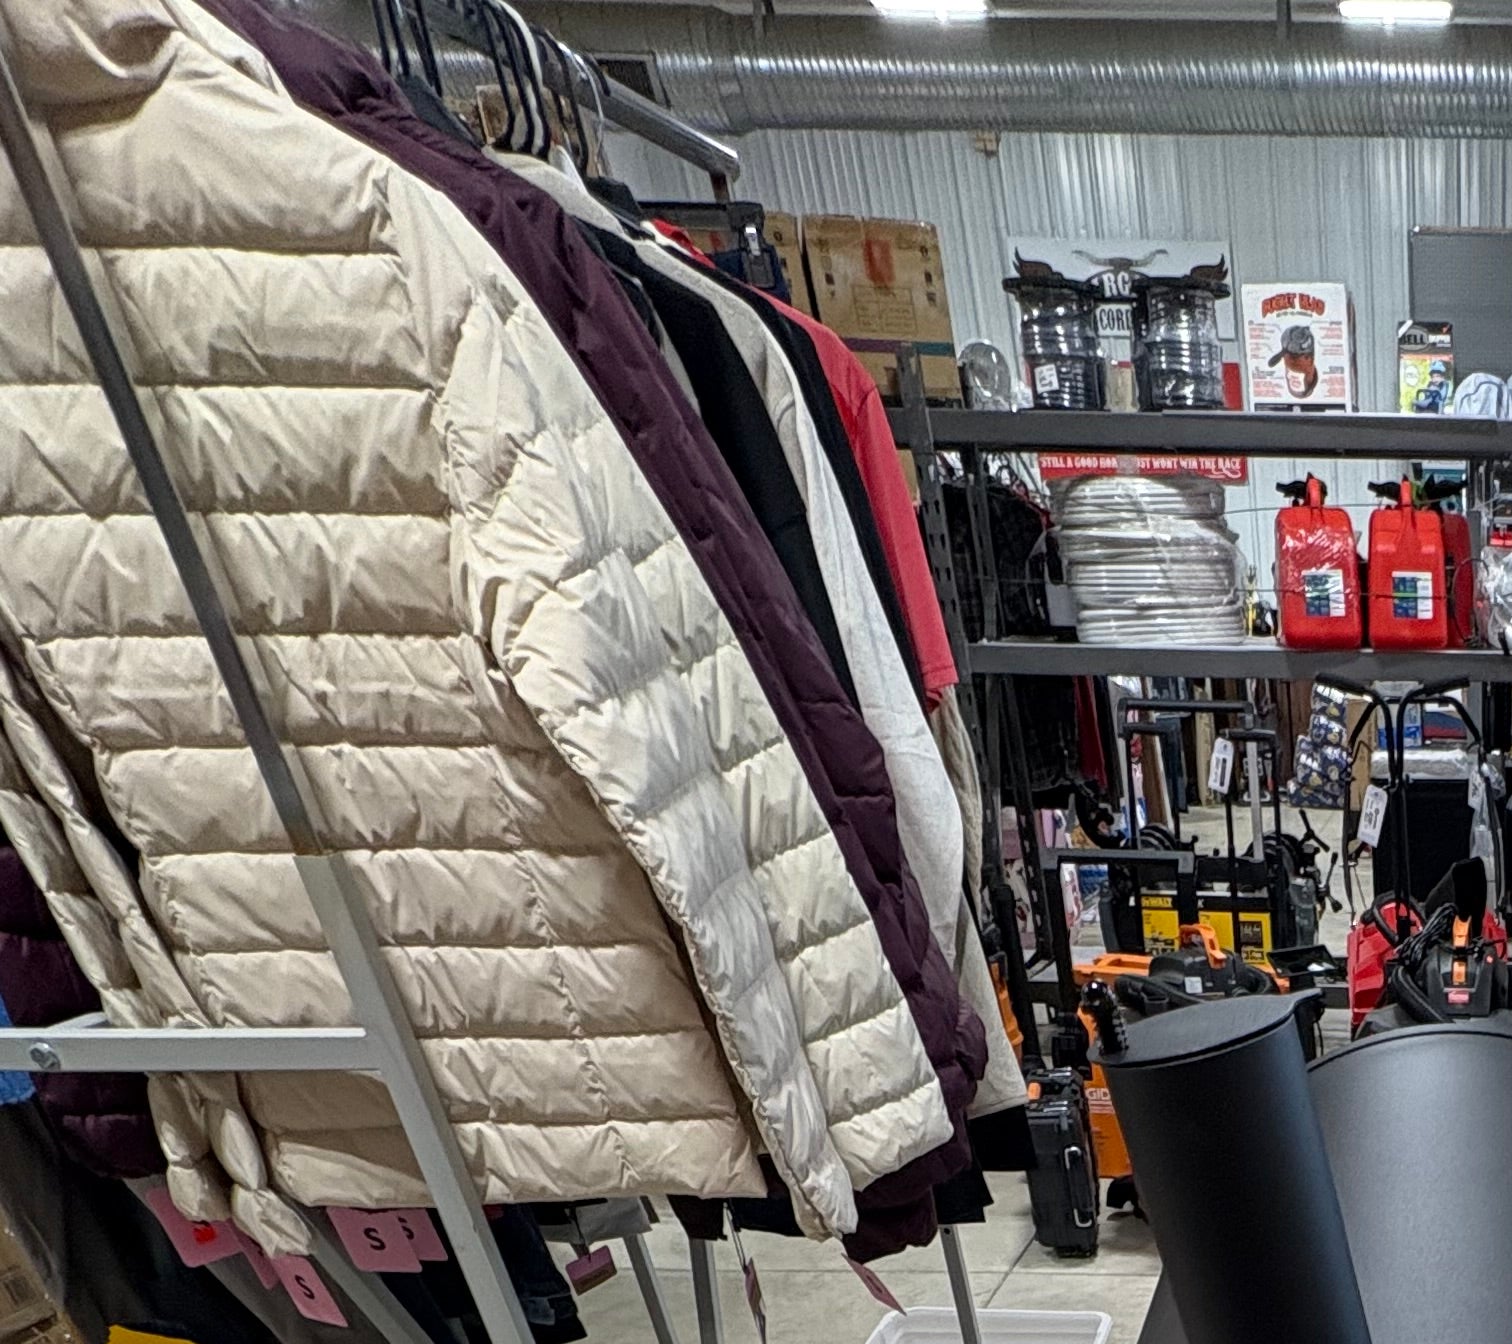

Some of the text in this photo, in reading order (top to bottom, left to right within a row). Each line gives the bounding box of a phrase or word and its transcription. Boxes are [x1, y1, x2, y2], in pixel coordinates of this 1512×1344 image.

[1041, 456, 1064, 468] STILL
[1066, 456, 1073, 468] A
[1074, 456, 1098, 469] GOOD
[363, 1227, 386, 1251] S
[294, 1274, 316, 1300] S
